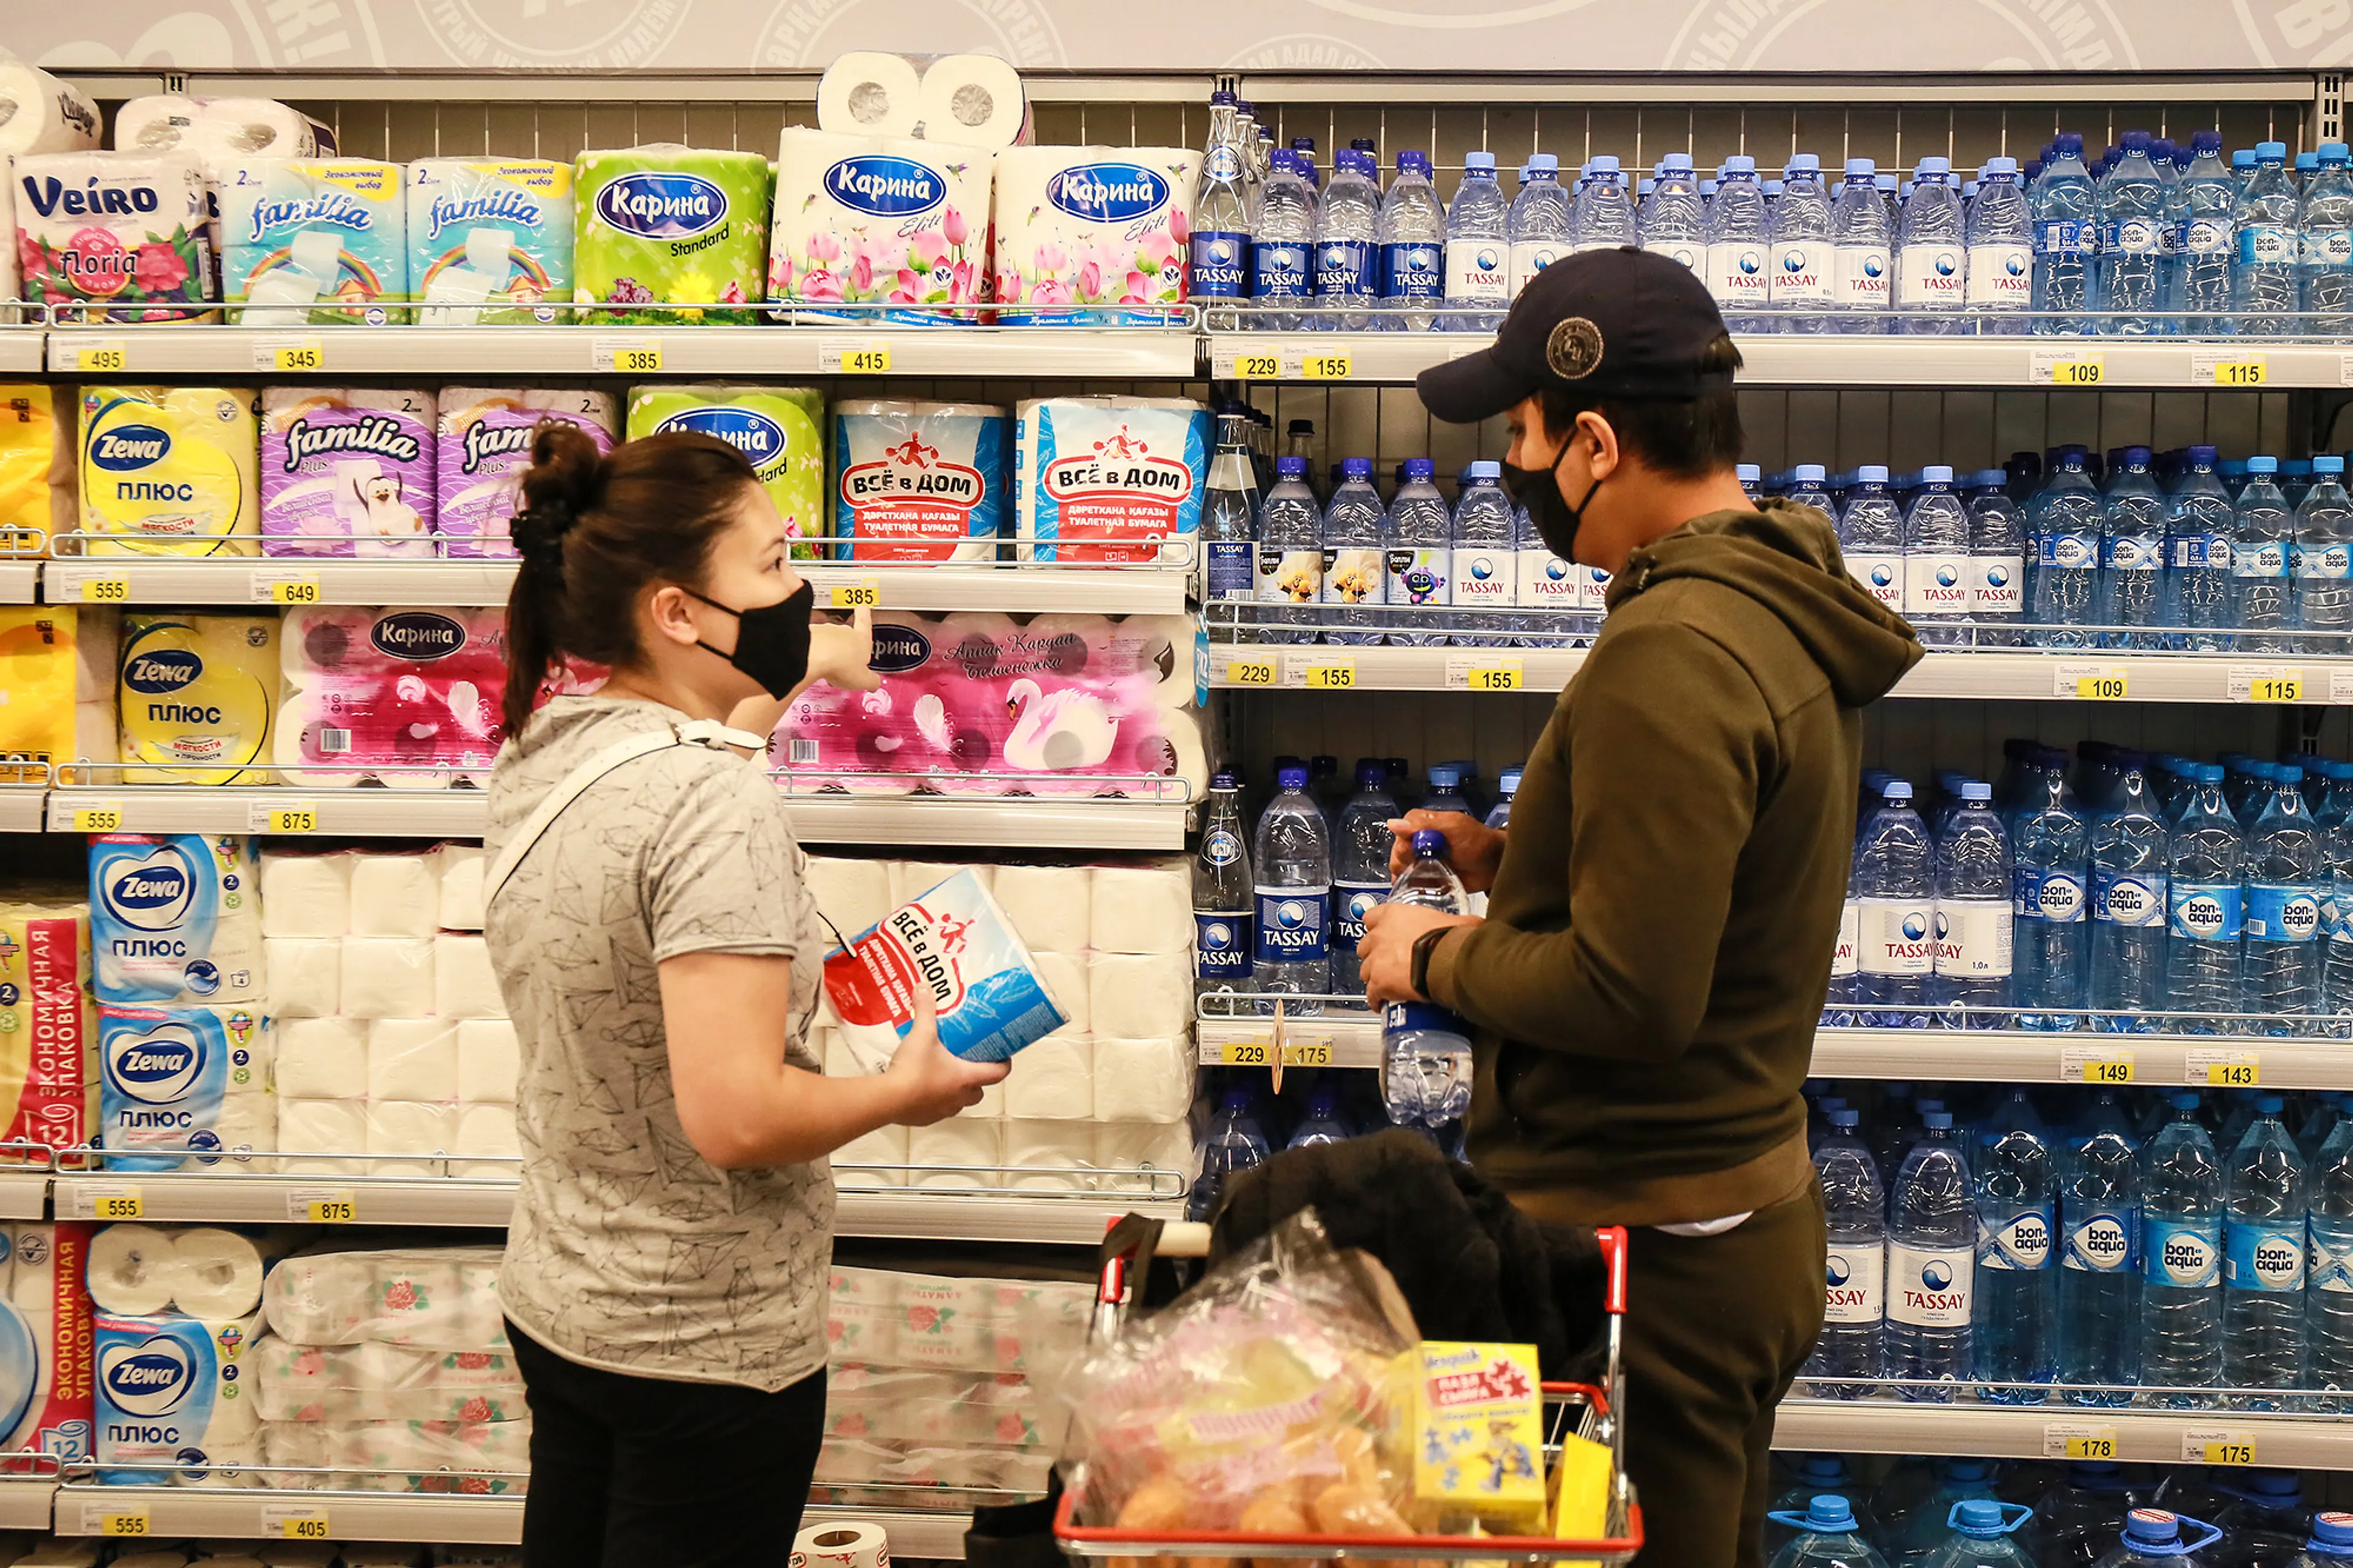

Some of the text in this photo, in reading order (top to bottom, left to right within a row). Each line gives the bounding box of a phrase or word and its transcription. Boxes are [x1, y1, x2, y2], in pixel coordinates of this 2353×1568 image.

[838, 163, 932, 201] Карина
[1061, 173, 1154, 209] Карина
[612, 184, 711, 223] Карина
[249, 194, 373, 243] familia
[427, 189, 544, 241] familia
[670, 224, 729, 258] Standard
[60, 248, 137, 280] floria
[1194, 268, 1245, 283] TASSAY
[1260, 272, 1305, 287] TASSAY
[1317, 271, 1359, 285] TASSAY
[1395, 273, 1439, 287] TASSAY
[1464, 272, 1506, 286] TASSAY
[1727, 276, 1767, 288] TASSAY
[1775, 275, 1818, 287] TASSAY
[1922, 278, 1961, 290] TASSAY
[91, 352, 120, 367] 495
[286, 351, 315, 367] 345
[628, 354, 657, 369] 385
[854, 354, 884, 369] 415
[1247, 360, 1276, 376] 229
[1317, 360, 1346, 376] 155
[2069, 365, 2099, 382] 109
[2229, 366, 2259, 383] 115
[99, 436, 164, 459] Zewa
[284, 415, 420, 473] familia
[853, 469, 895, 494] ВСЁ
[917, 474, 971, 496] ДОМ
[1059, 463, 1101, 487] ВСЁ
[1124, 469, 1180, 491] ДОМ
[117, 482, 193, 502] ПЛЮС
[863, 521, 959, 533] ТУАЛЕТНАЯ БУМАГА
[1069, 517, 1167, 529] ТУАЛЕТНАЯ БУМАГА
[96, 583, 124, 598] 555
[286, 585, 314, 601] 649
[1460, 582, 1505, 594] TASSAY
[1533, 583, 1577, 595] TASSAY
[1866, 589, 1901, 600] ASSAY
[1923, 589, 1966, 600] TASSAY
[1974, 589, 2019, 601] TASSAY
[844, 589, 874, 604] 385
[382, 623, 453, 646] Карина
[134, 659, 194, 683] Zewa
[963, 657, 1063, 680] Белоснежка
[1241, 665, 1270, 682] 229
[1321, 669, 1351, 685] 155
[1482, 672, 1512, 689] 155
[2093, 680, 2123, 697] 109
[2265, 682, 2295, 699] 115
[148, 704, 222, 725] ПЛЮС
[173, 740, 222, 752] МЯГКОСТИ
[88, 812, 116, 828] 555
[282, 814, 311, 829] 875
[122, 877, 180, 898] Zewa
[2039, 894, 2073, 907] aqua
[2109, 898, 2143, 911] aqua
[2188, 912, 2222, 925] aqua
[2283, 914, 2314, 926] aqua
[1264, 930, 1320, 946] TASSAY
[113, 939, 187, 957] ПЛЮС
[1885, 942, 1934, 958] TASSAY
[893, 912, 929, 943] ВСЁ
[917, 954, 952, 1002] ДОМ
[31, 930, 56, 1097] ЭКОНОМИЧНАЯ
[56, 980, 77, 1097] УПАКОВКА
[126, 1051, 186, 1072] Zewa
[1235, 1047, 1264, 1063] 229
[1298, 1047, 1327, 1063] 175
[2098, 1064, 2128, 1081] 149
[2222, 1067, 2252, 1083] 143
[120, 1110, 192, 1129] ПЛЮС
[108, 1200, 137, 1216] 555
[322, 1204, 350, 1219] 875
[2014, 1237, 2048, 1250] aqua
[2088, 1239, 2125, 1252] aqua
[2164, 1255, 2203, 1270] aqua
[2256, 1259, 2294, 1272] aqua
[1826, 1290, 1867, 1306] SSAY
[1904, 1290, 1966, 1309] TASSAY
[57, 1241, 75, 1401] ЭКОНОМИЧНАЯ
[77, 1290, 92, 1398] УПАКОВКА
[116, 1362, 178, 1385] Zewa
[108, 1423, 180, 1444] ПЛЮС
[2081, 1441, 2111, 1456] 178
[2220, 1446, 2250, 1463] 175
[116, 1518, 144, 1534] 555
[297, 1521, 325, 1536] 405
